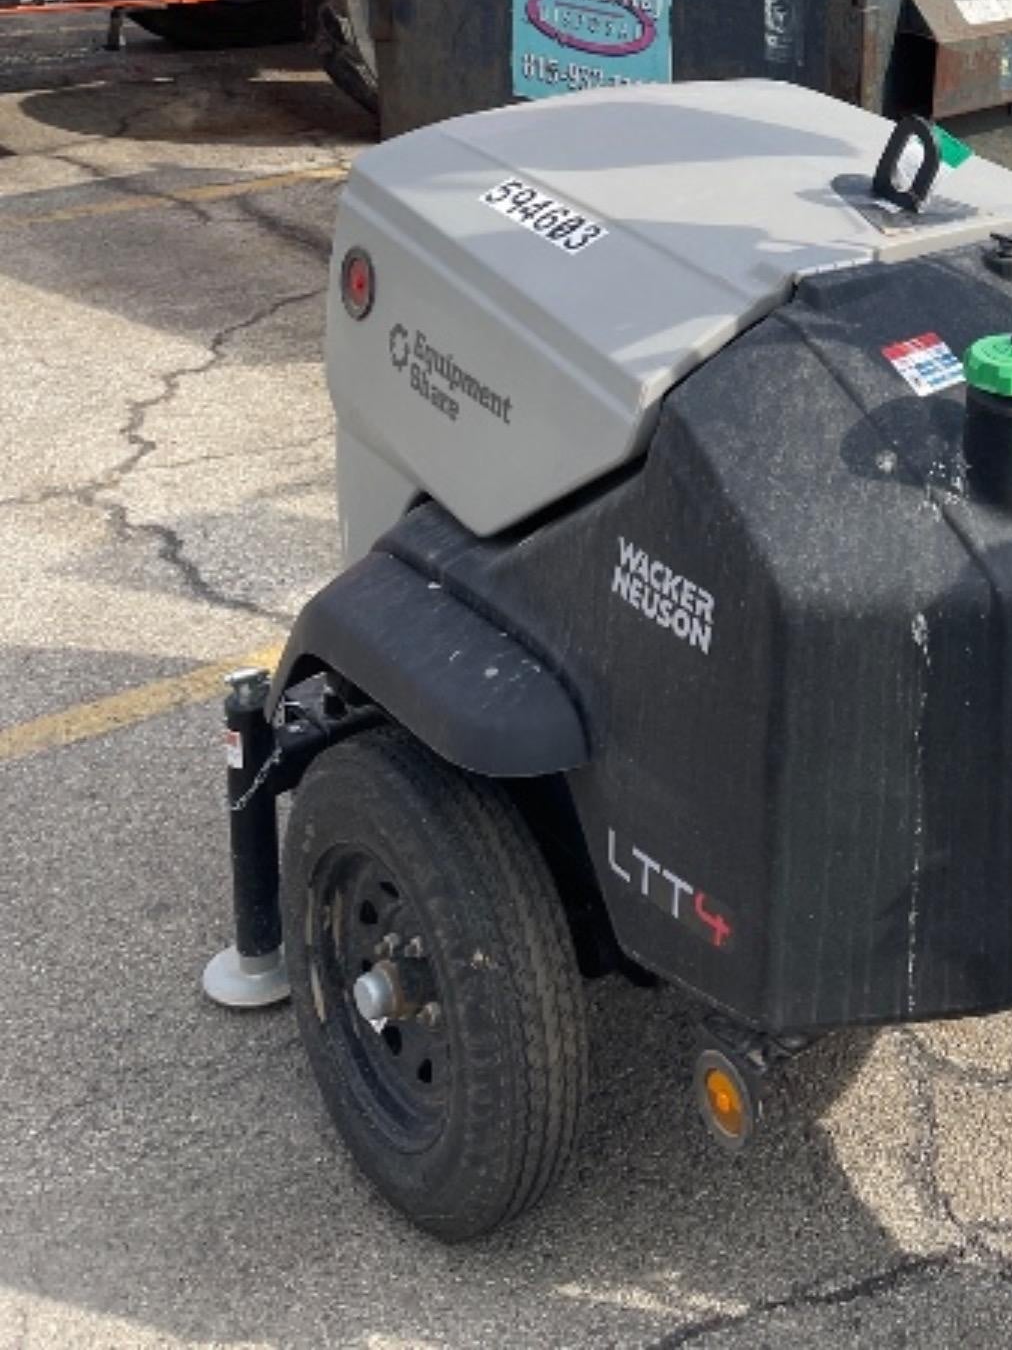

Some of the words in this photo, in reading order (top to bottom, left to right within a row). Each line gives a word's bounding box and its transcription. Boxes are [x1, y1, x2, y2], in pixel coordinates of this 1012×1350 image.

[410, 361, 460, 421] Share
[414, 329, 513, 425] Equipment
[611, 564, 712, 656] NEUSON
[618, 536, 715, 625] WACKER
[608, 826, 731, 947] LTT4
